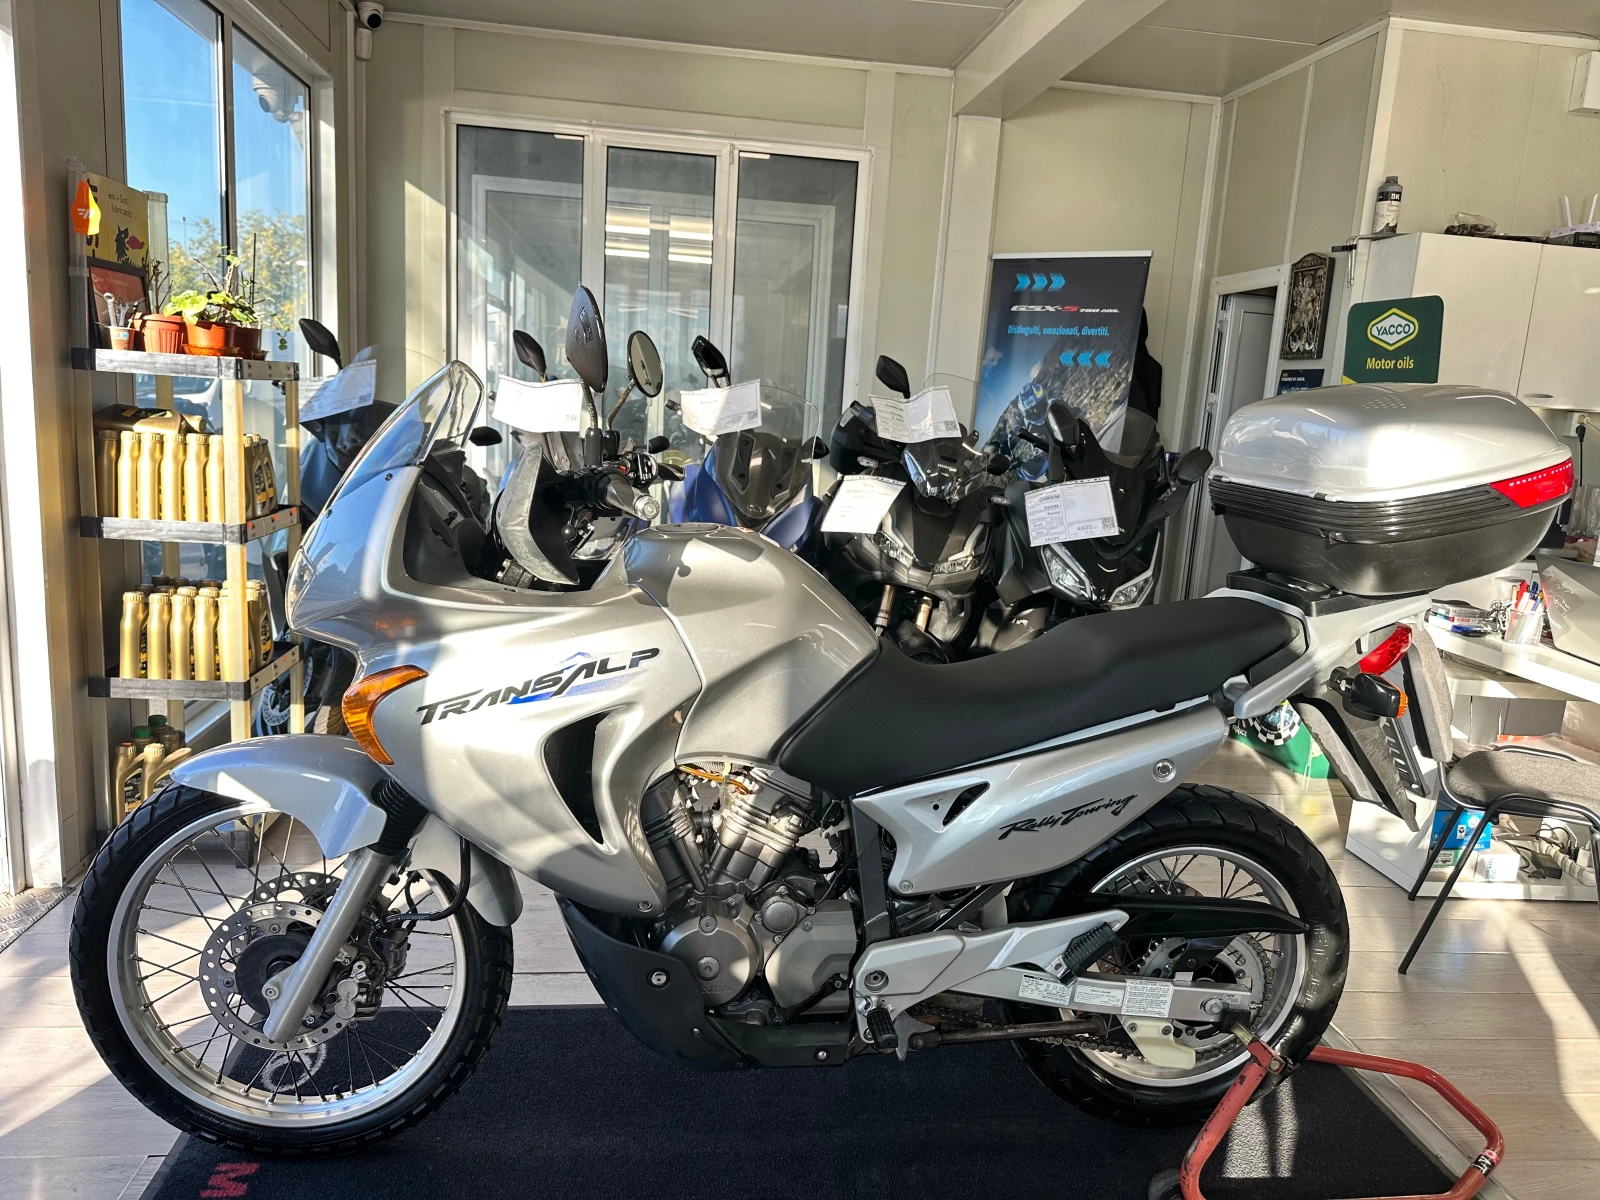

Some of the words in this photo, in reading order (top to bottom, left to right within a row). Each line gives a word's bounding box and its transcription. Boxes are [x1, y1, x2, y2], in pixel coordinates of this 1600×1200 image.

[1007, 325, 1041, 337] Distinguiti,
[1042, 326, 1080, 337] emozionati,
[1081, 326, 1109, 336] divertiti.
[1376, 323, 1411, 336] YACCO
[1366, 357, 1395, 370] Motor
[1397, 356, 1414, 369] oils
[416, 647, 661, 726] TRANSALP
[998, 815, 1063, 841] Rally
[1060, 793, 1139, 826] Touring
